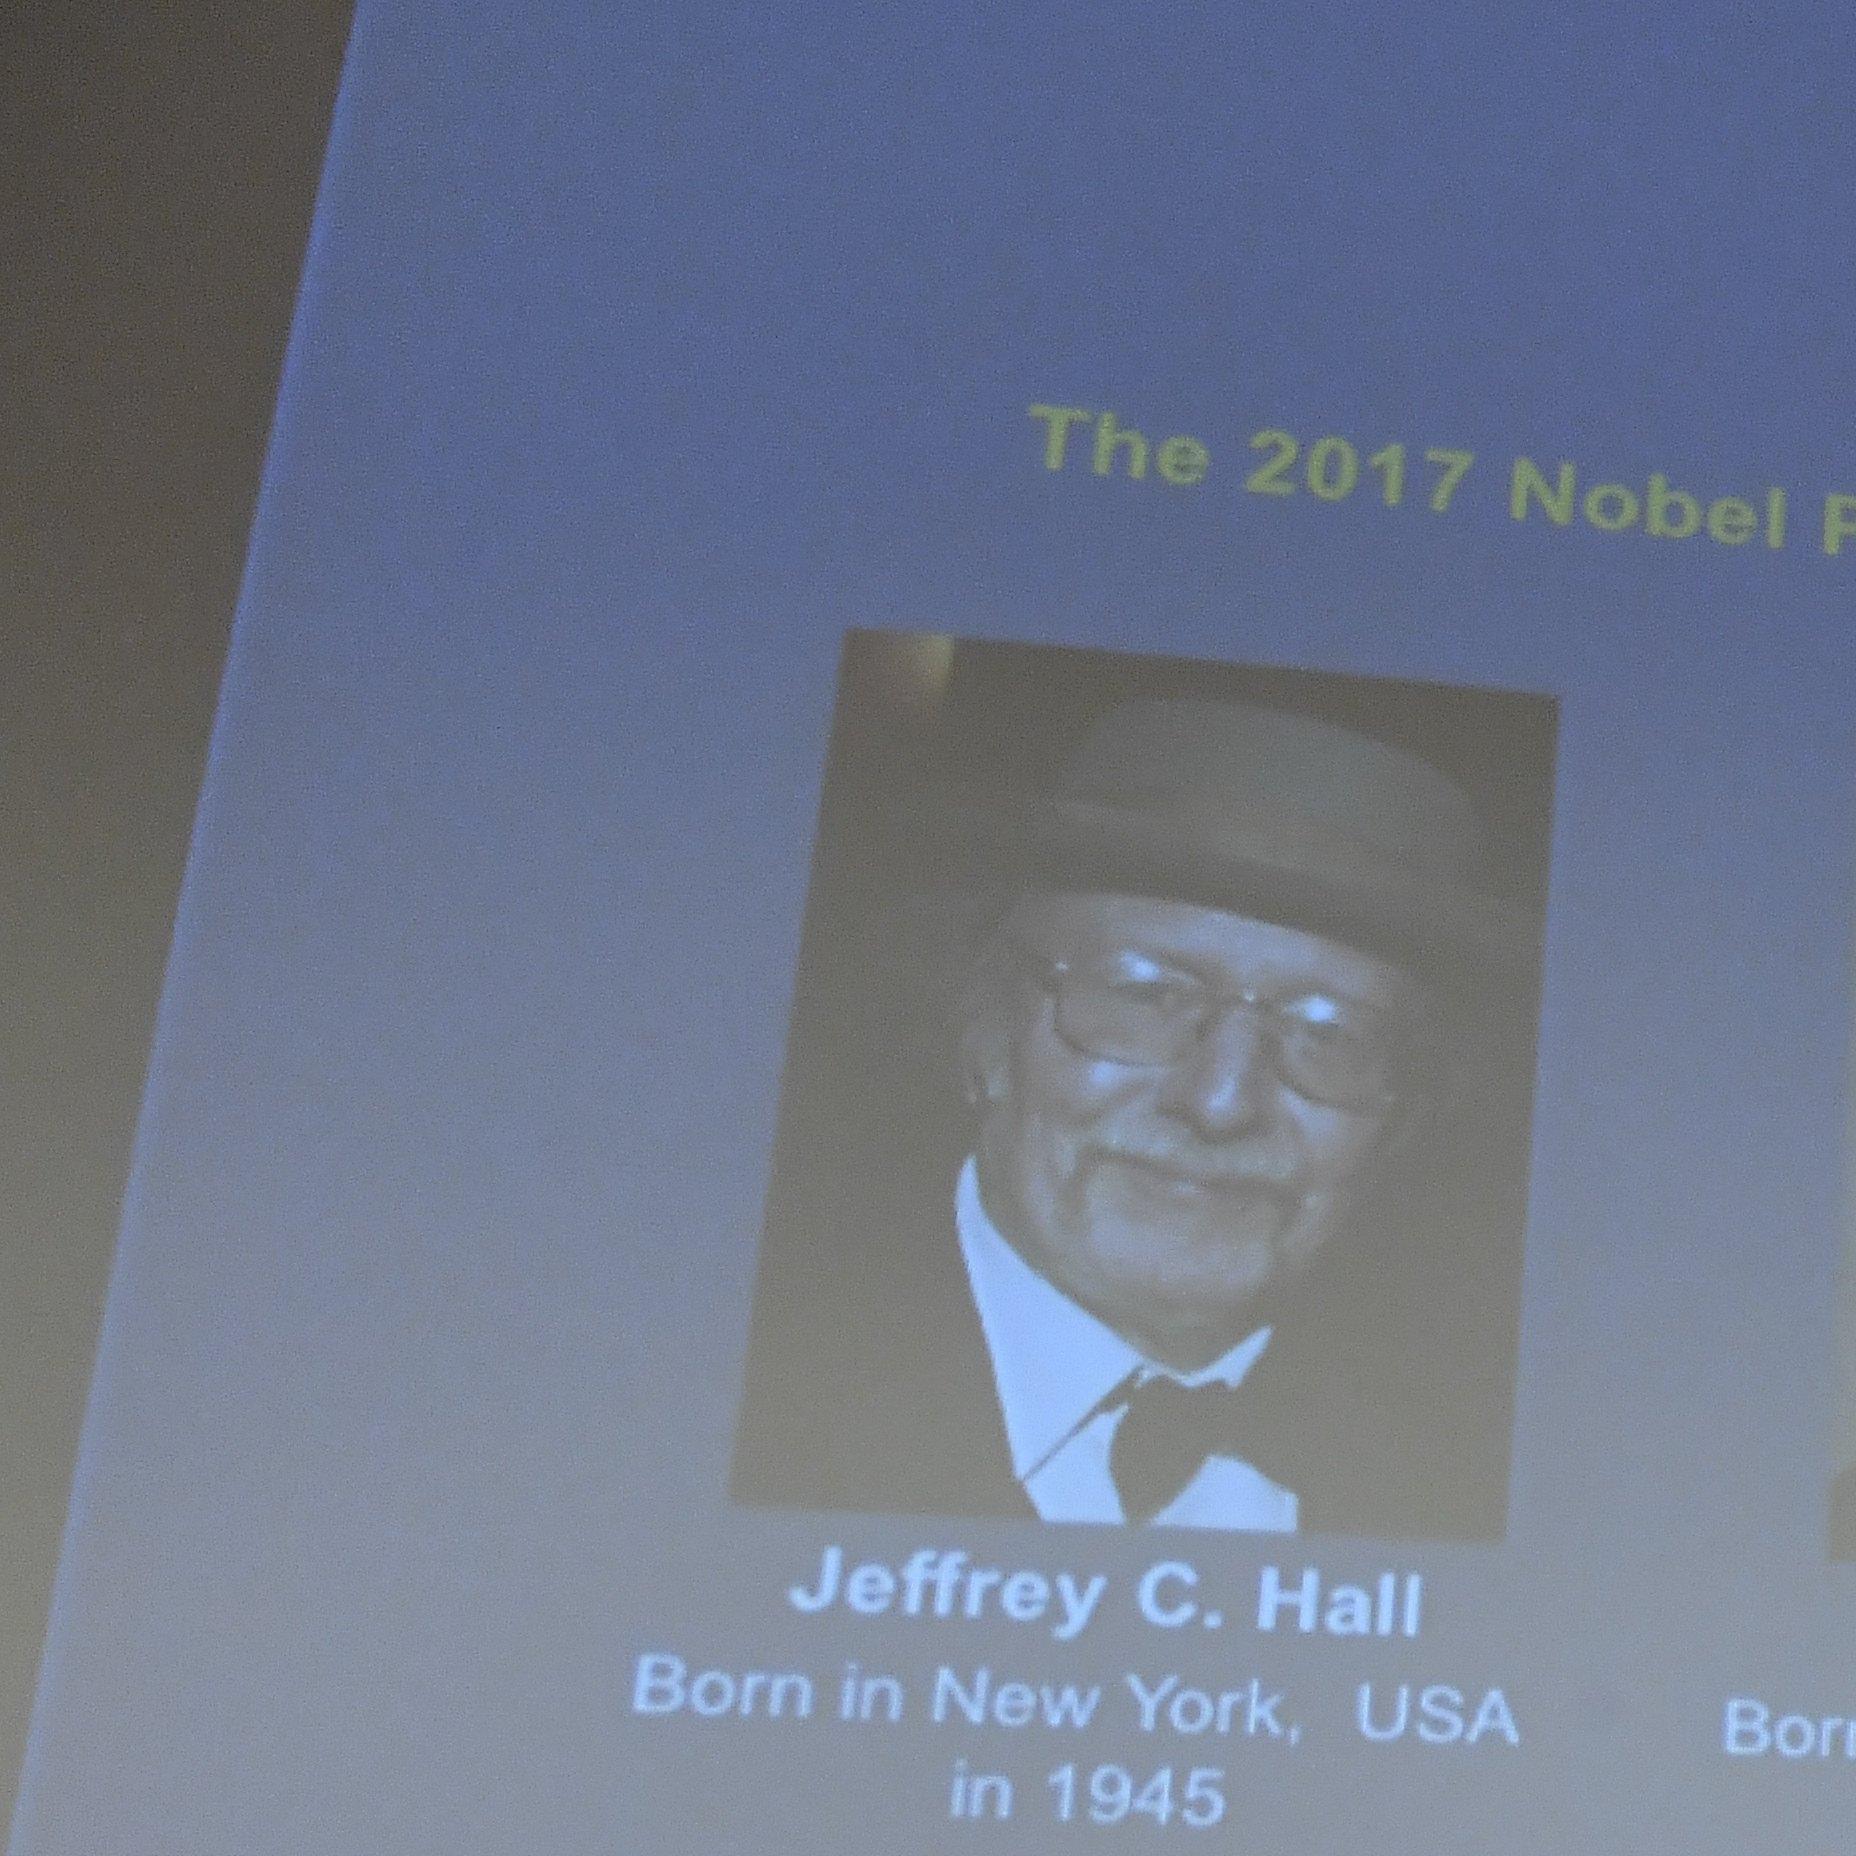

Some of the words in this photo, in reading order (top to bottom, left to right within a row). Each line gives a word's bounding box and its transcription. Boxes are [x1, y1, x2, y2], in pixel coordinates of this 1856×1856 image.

[1030, 405, 1210, 485] The
[1244, 430, 1475, 511] 2017
[1509, 456, 1786, 550] Nobel
[787, 1547, 1107, 1639] Jeffrey
[1138, 1561, 1223, 1629] C.
[1255, 1567, 1422, 1637] Hall
[632, 1653, 812, 1718] Born
[840, 1662, 903, 1722] in
[933, 1666, 1100, 1730] New
[1126, 1675, 1302, 1745] York,
[1356, 1684, 1521, 1745] USA
[949, 1760, 1012, 1820] in
[1047, 1765, 1226, 1828] 1945
